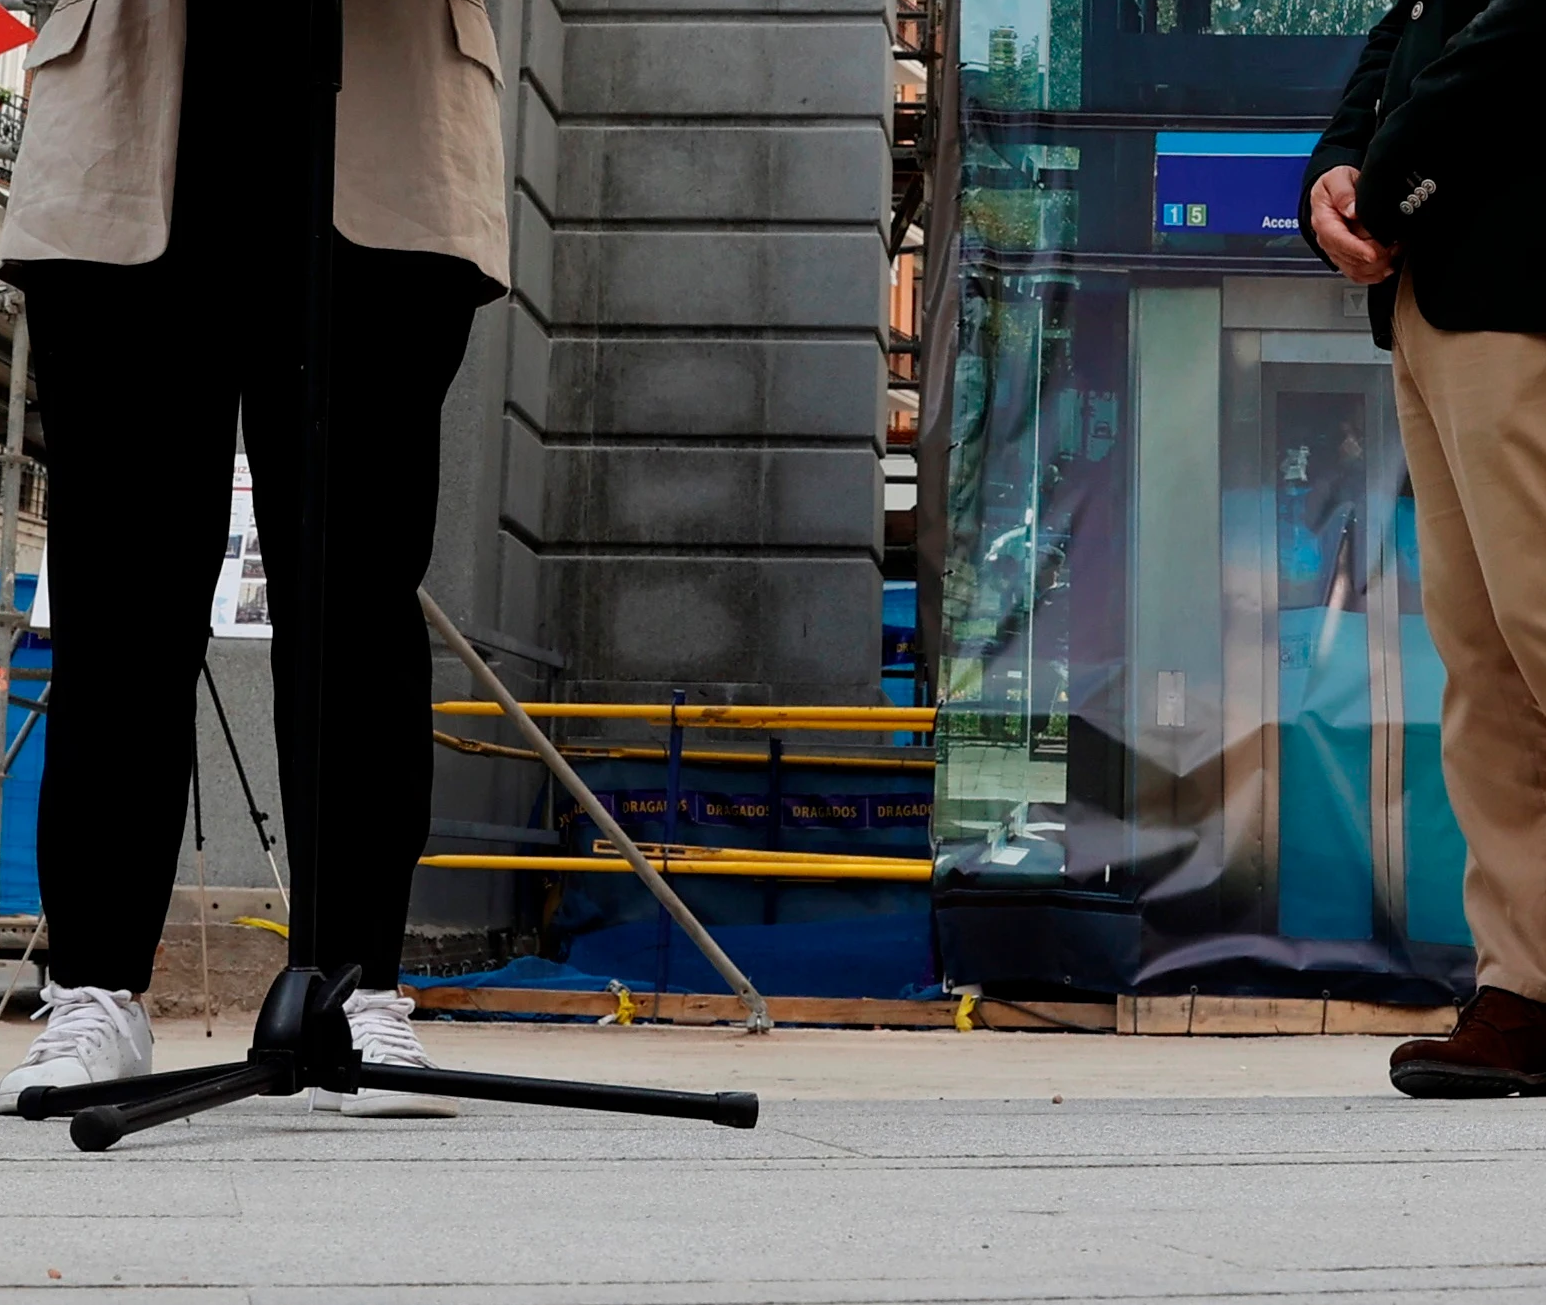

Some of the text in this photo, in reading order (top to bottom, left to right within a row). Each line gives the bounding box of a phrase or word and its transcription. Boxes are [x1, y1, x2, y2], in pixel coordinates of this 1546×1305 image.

[1170, 207, 1300, 229] 1 5 Acces
